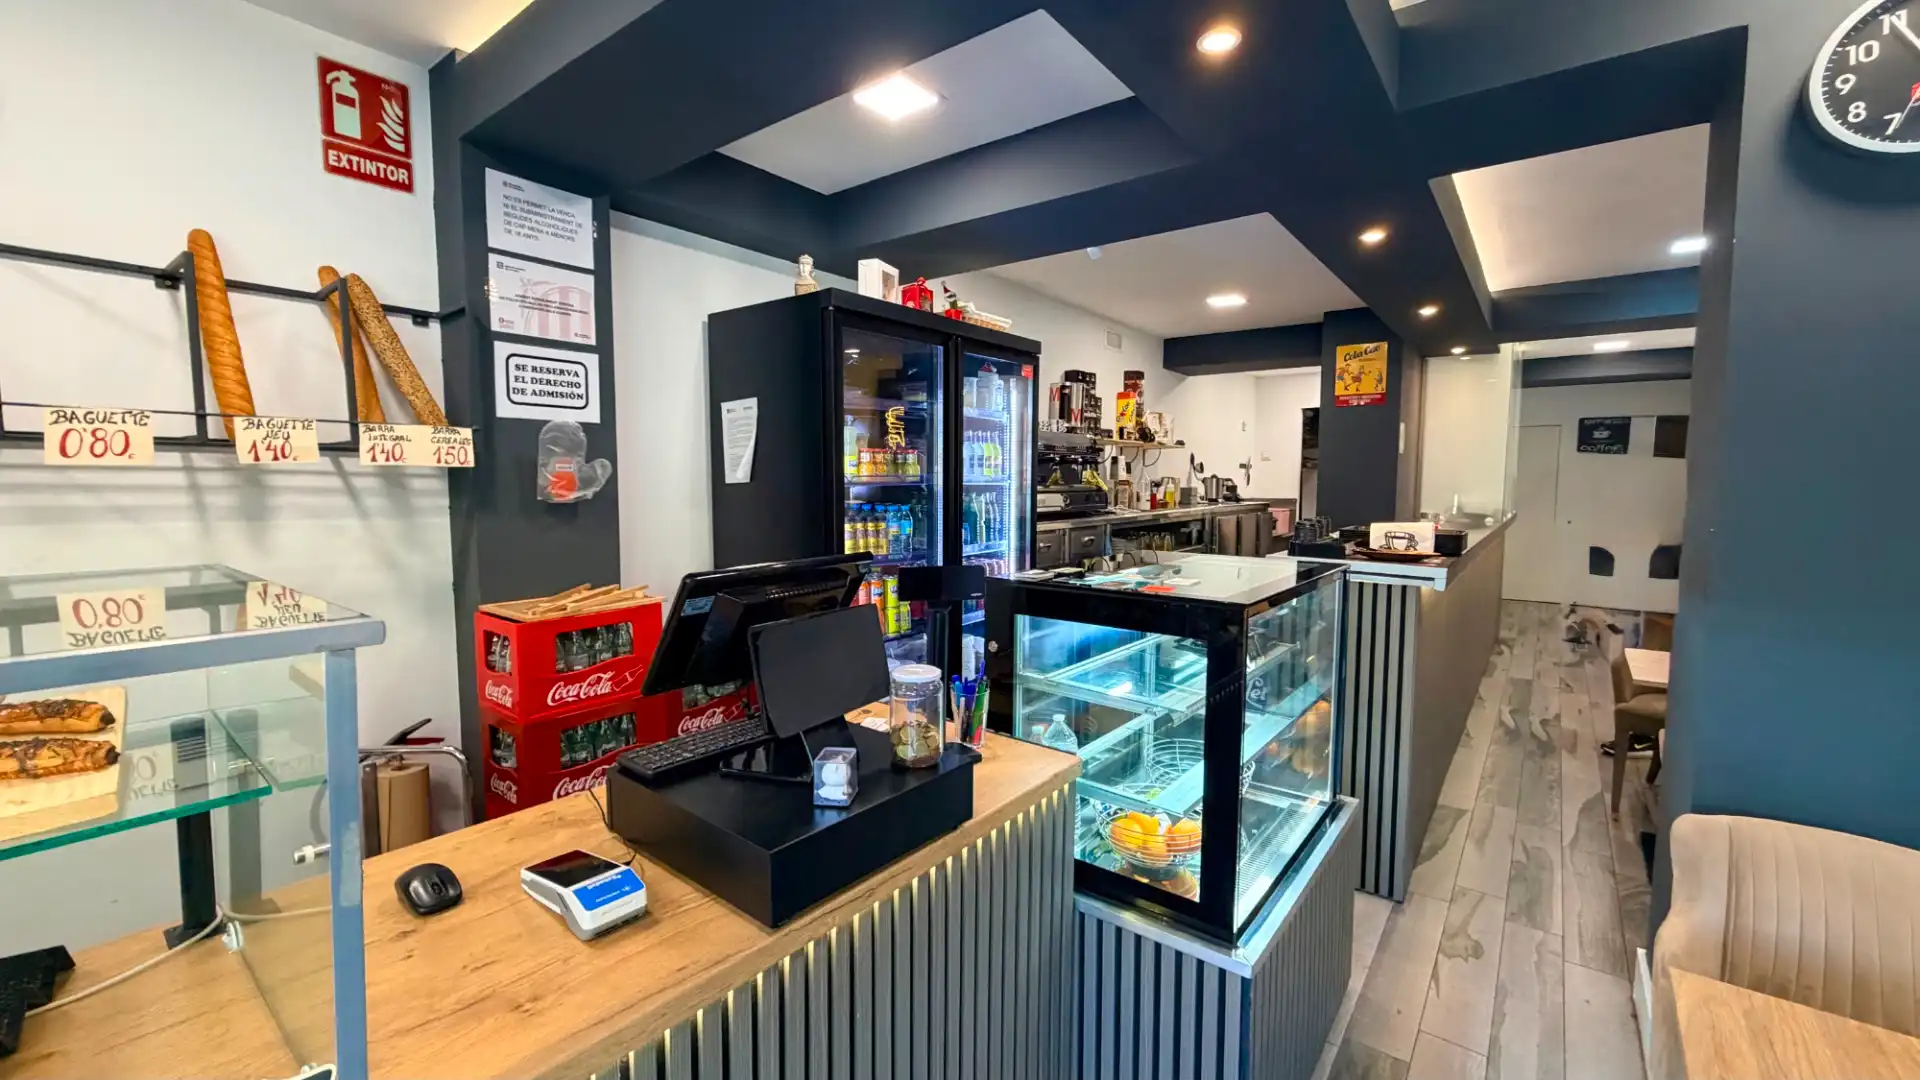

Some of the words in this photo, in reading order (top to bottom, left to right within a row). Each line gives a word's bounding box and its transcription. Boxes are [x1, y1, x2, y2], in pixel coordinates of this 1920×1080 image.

[1845, 40, 1880, 66] 10
[1835, 73, 1857, 95] 9
[1847, 101, 1867, 123] 8
[1883, 112, 1902, 136] 7
[327, 149, 409, 185] EXTINTOR
[514, 363, 528, 373] SE
[531, 365, 580, 378] RESERVA
[514, 375, 528, 384] EL
[530, 377, 582, 390] DERECHO
[512, 387, 528, 396] DE
[530, 387, 584, 400] ADMISIÓN
[49, 409, 150, 427] BAGUETTE
[242, 418, 314, 431] BAGUETTE
[363, 424, 395, 434] BARRA
[431, 425, 461, 436] BARRA
[368, 433, 412, 442] INTEGRAL
[431, 436, 471, 446] CEREALES
[547, 670, 615, 706] Coca-Cola
